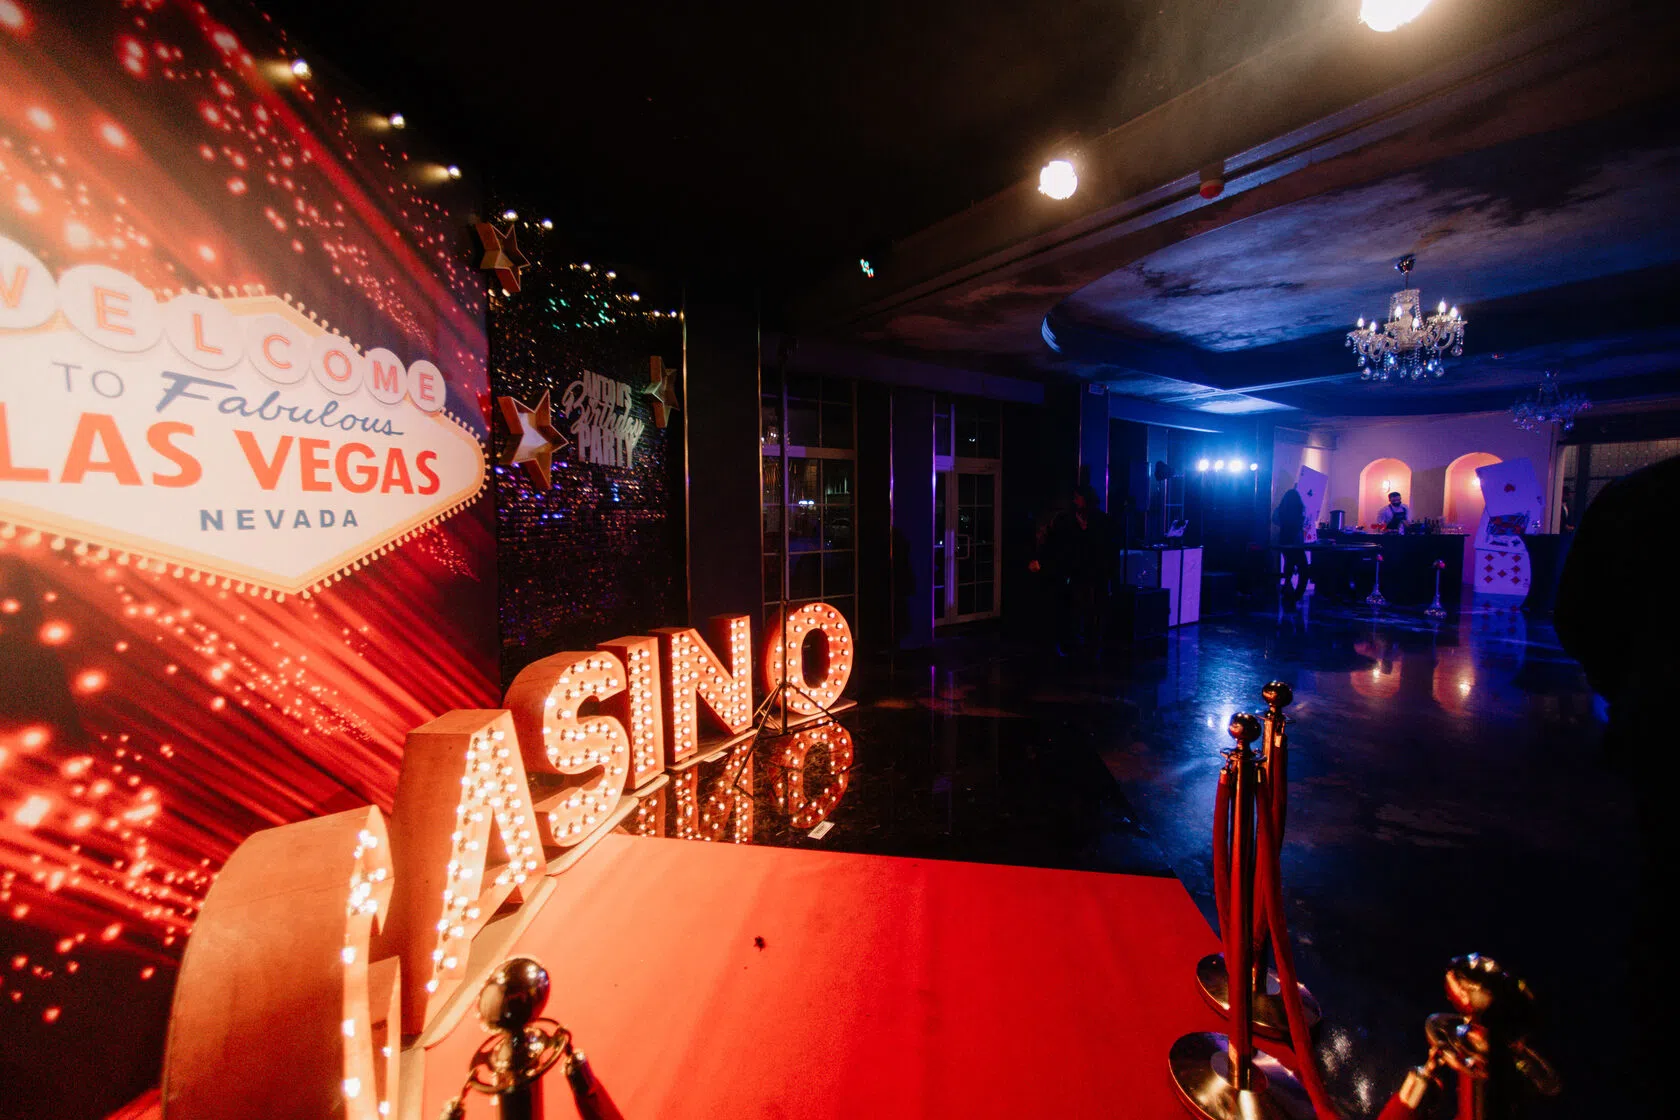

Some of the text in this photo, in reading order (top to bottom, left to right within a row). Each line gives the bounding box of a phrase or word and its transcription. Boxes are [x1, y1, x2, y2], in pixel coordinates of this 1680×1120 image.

[52, 361, 404, 437] TO Fabulous
[0, 402, 440, 496] LAS VEGAS
[578, 424, 634, 468] PARTY
[201, 509, 358, 532] NEVADA
